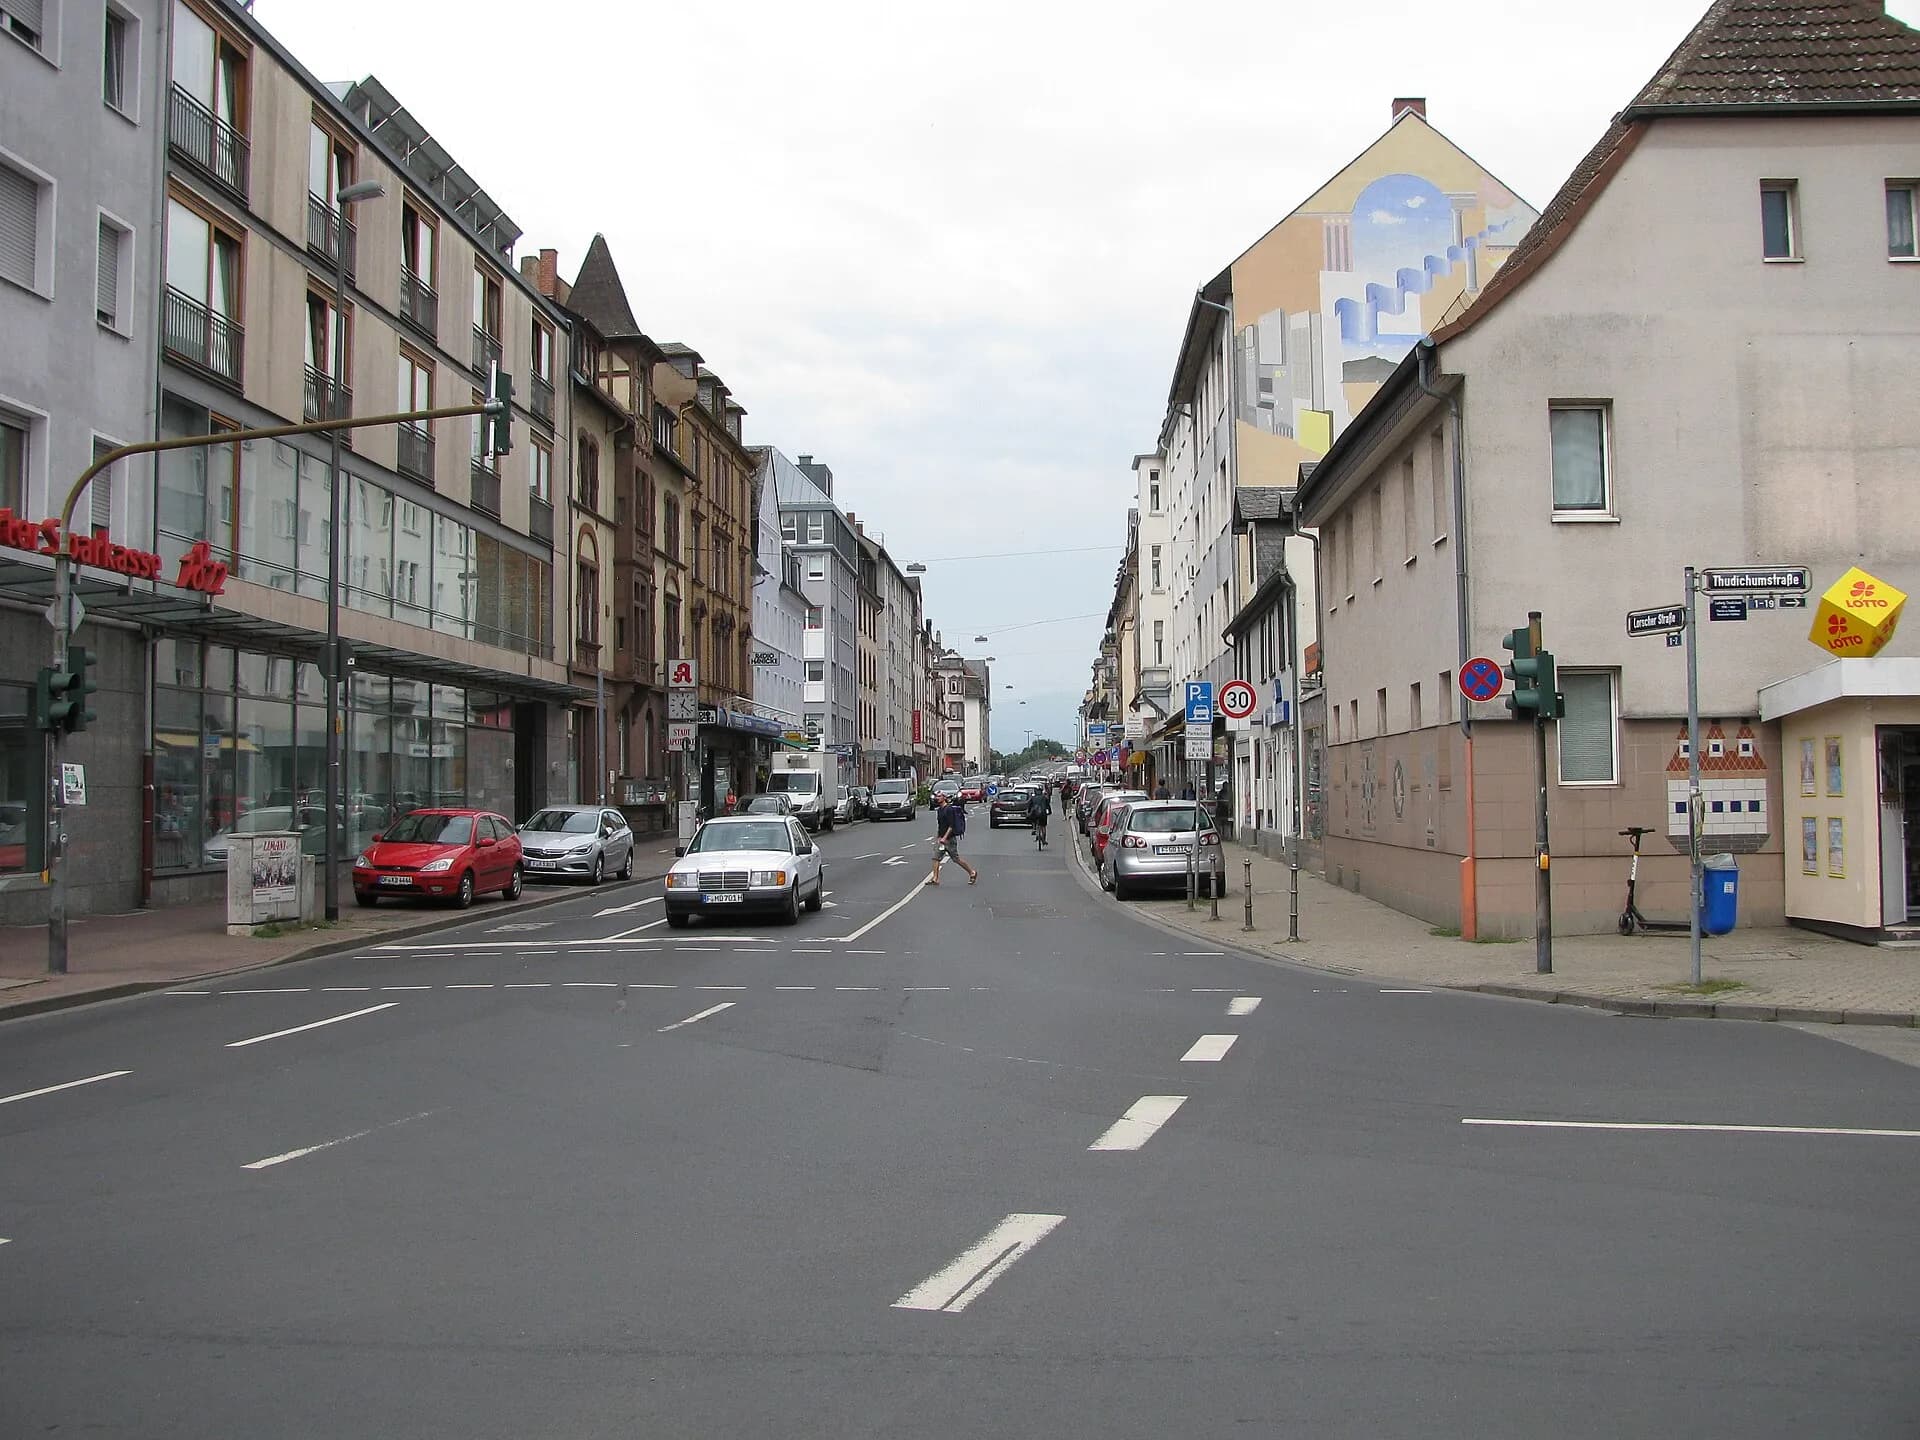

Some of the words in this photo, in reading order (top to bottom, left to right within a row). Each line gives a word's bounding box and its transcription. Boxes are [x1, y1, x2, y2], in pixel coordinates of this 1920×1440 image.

[1713, 574, 1799, 587] Thudichumstraße
[1754, 599, 1775, 608] 1-19
[1846, 599, 1888, 608] LOTTO
[1633, 615, 1657, 629] Lorscher
[1658, 612, 1676, 625] Straße
[1827, 635, 1863, 649] LOTTO
[1190, 685, 1201, 701] P
[1227, 691, 1249, 708] 30
[673, 728, 690, 736] STADT
